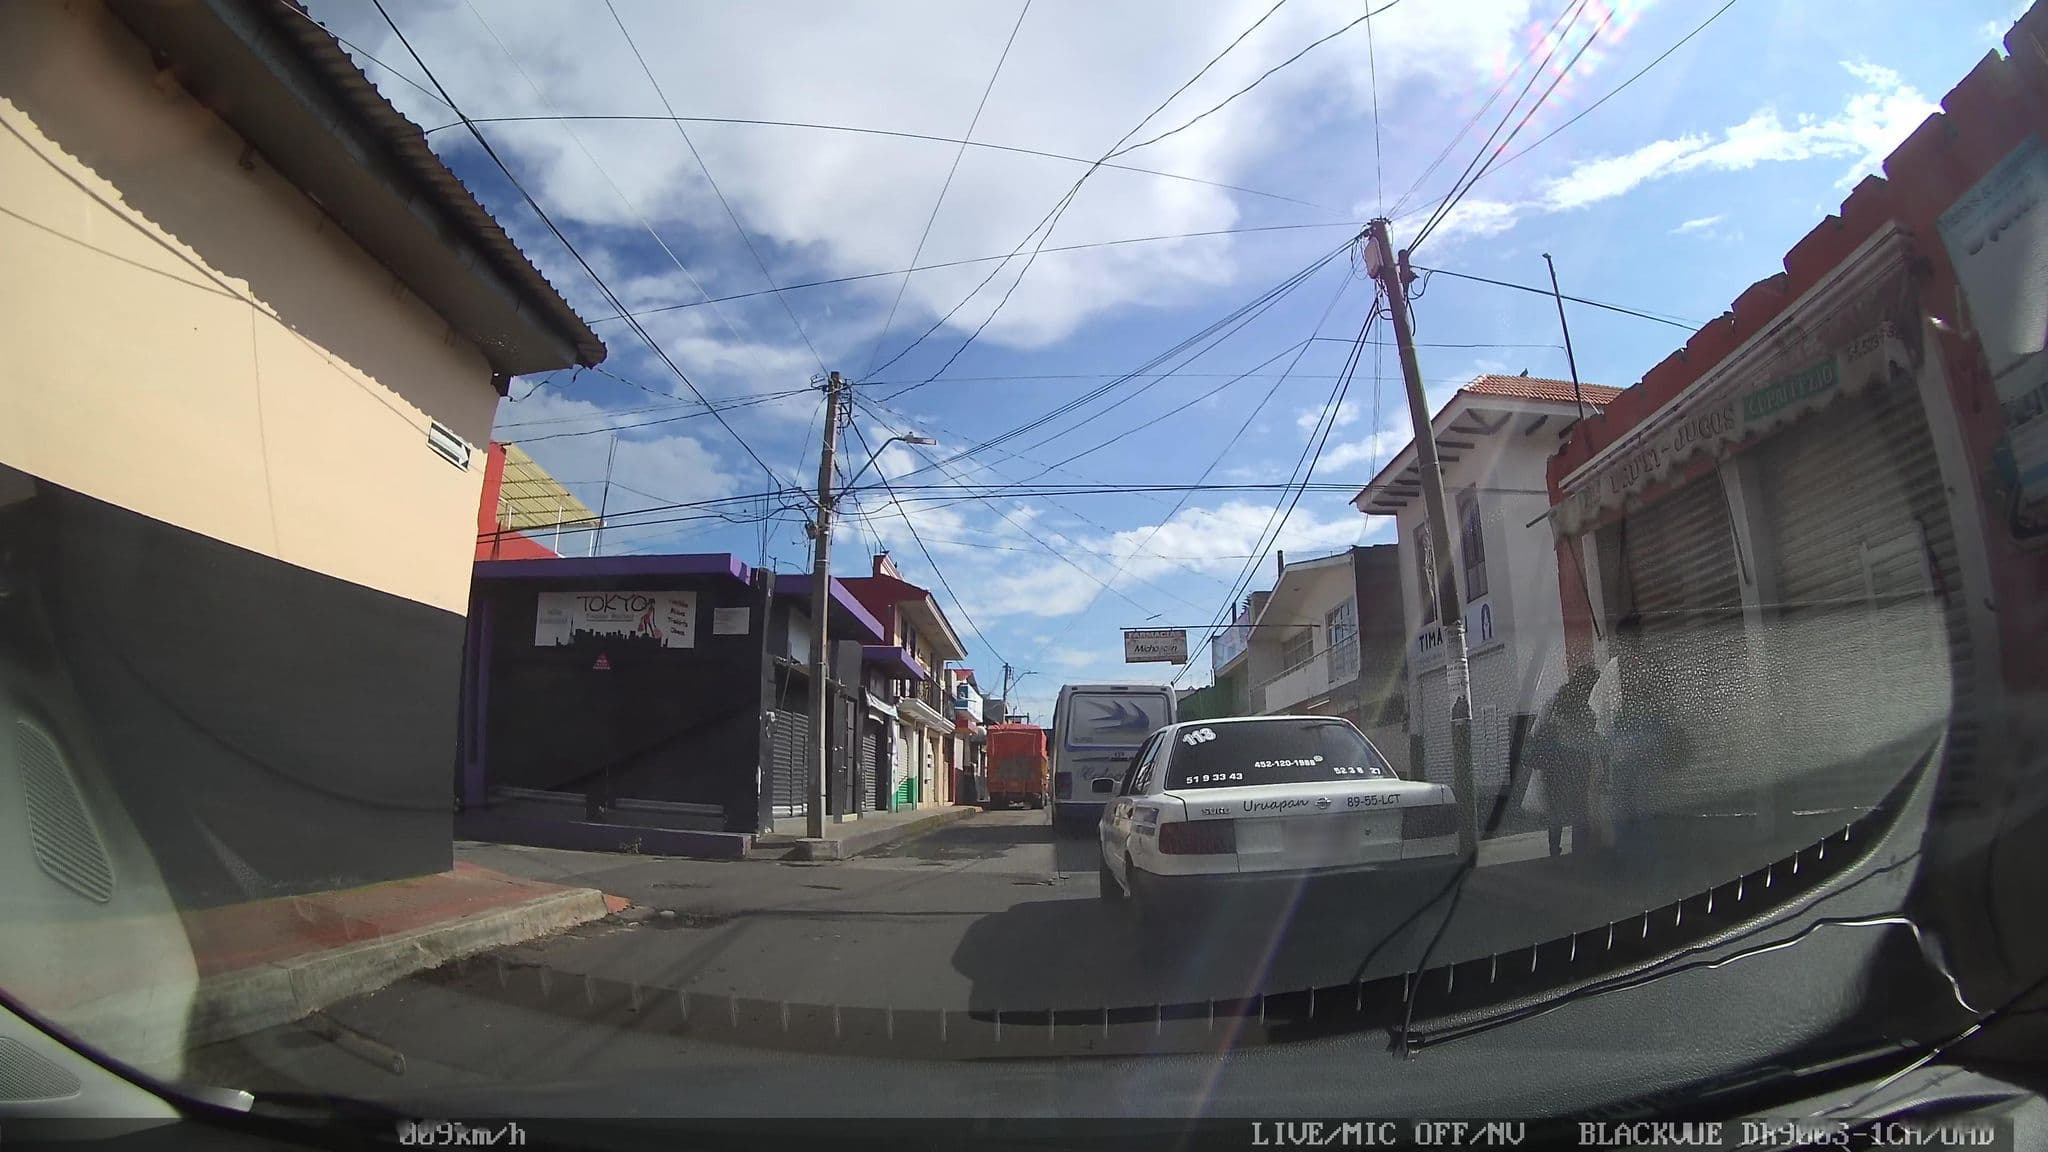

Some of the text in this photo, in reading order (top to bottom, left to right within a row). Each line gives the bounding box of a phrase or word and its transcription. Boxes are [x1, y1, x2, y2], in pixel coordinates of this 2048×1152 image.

[576, 594, 648, 613] TOKYO
[1182, 728, 1217, 746] 113
[1243, 798, 1309, 813] Uruapan
[1346, 794, 1401, 809] 89-55-LCT
